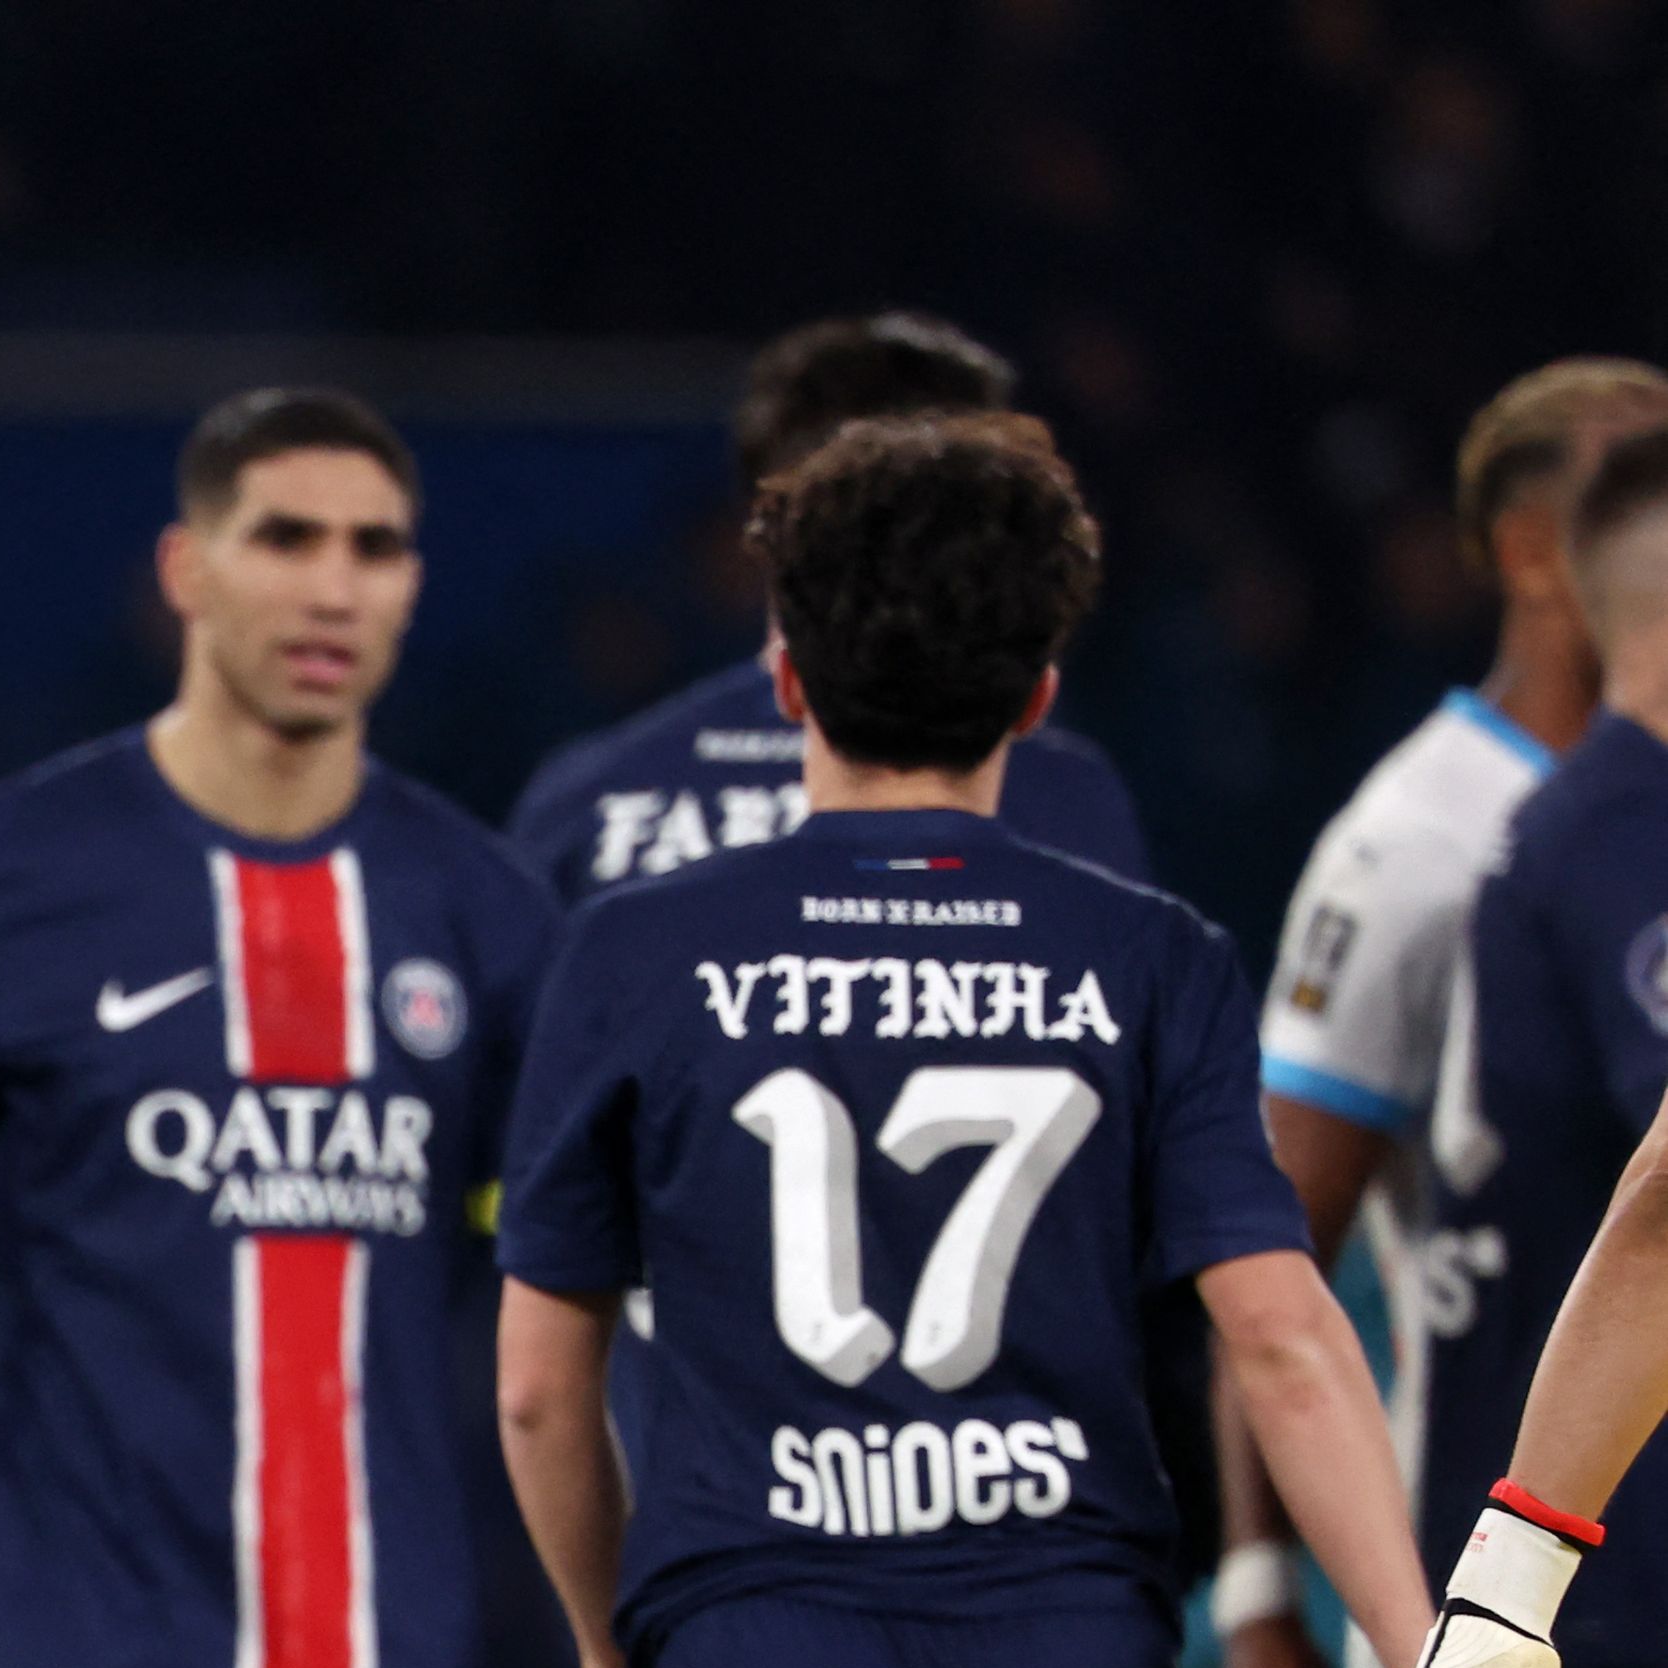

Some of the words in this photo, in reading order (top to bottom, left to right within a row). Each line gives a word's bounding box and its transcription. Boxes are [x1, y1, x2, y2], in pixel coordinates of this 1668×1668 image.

[801, 896, 883, 924] BORN
[694, 953, 1121, 1046] VITINHA
[125, 1086, 432, 1193] QATAR
[731, 1064, 1103, 1393] 17
